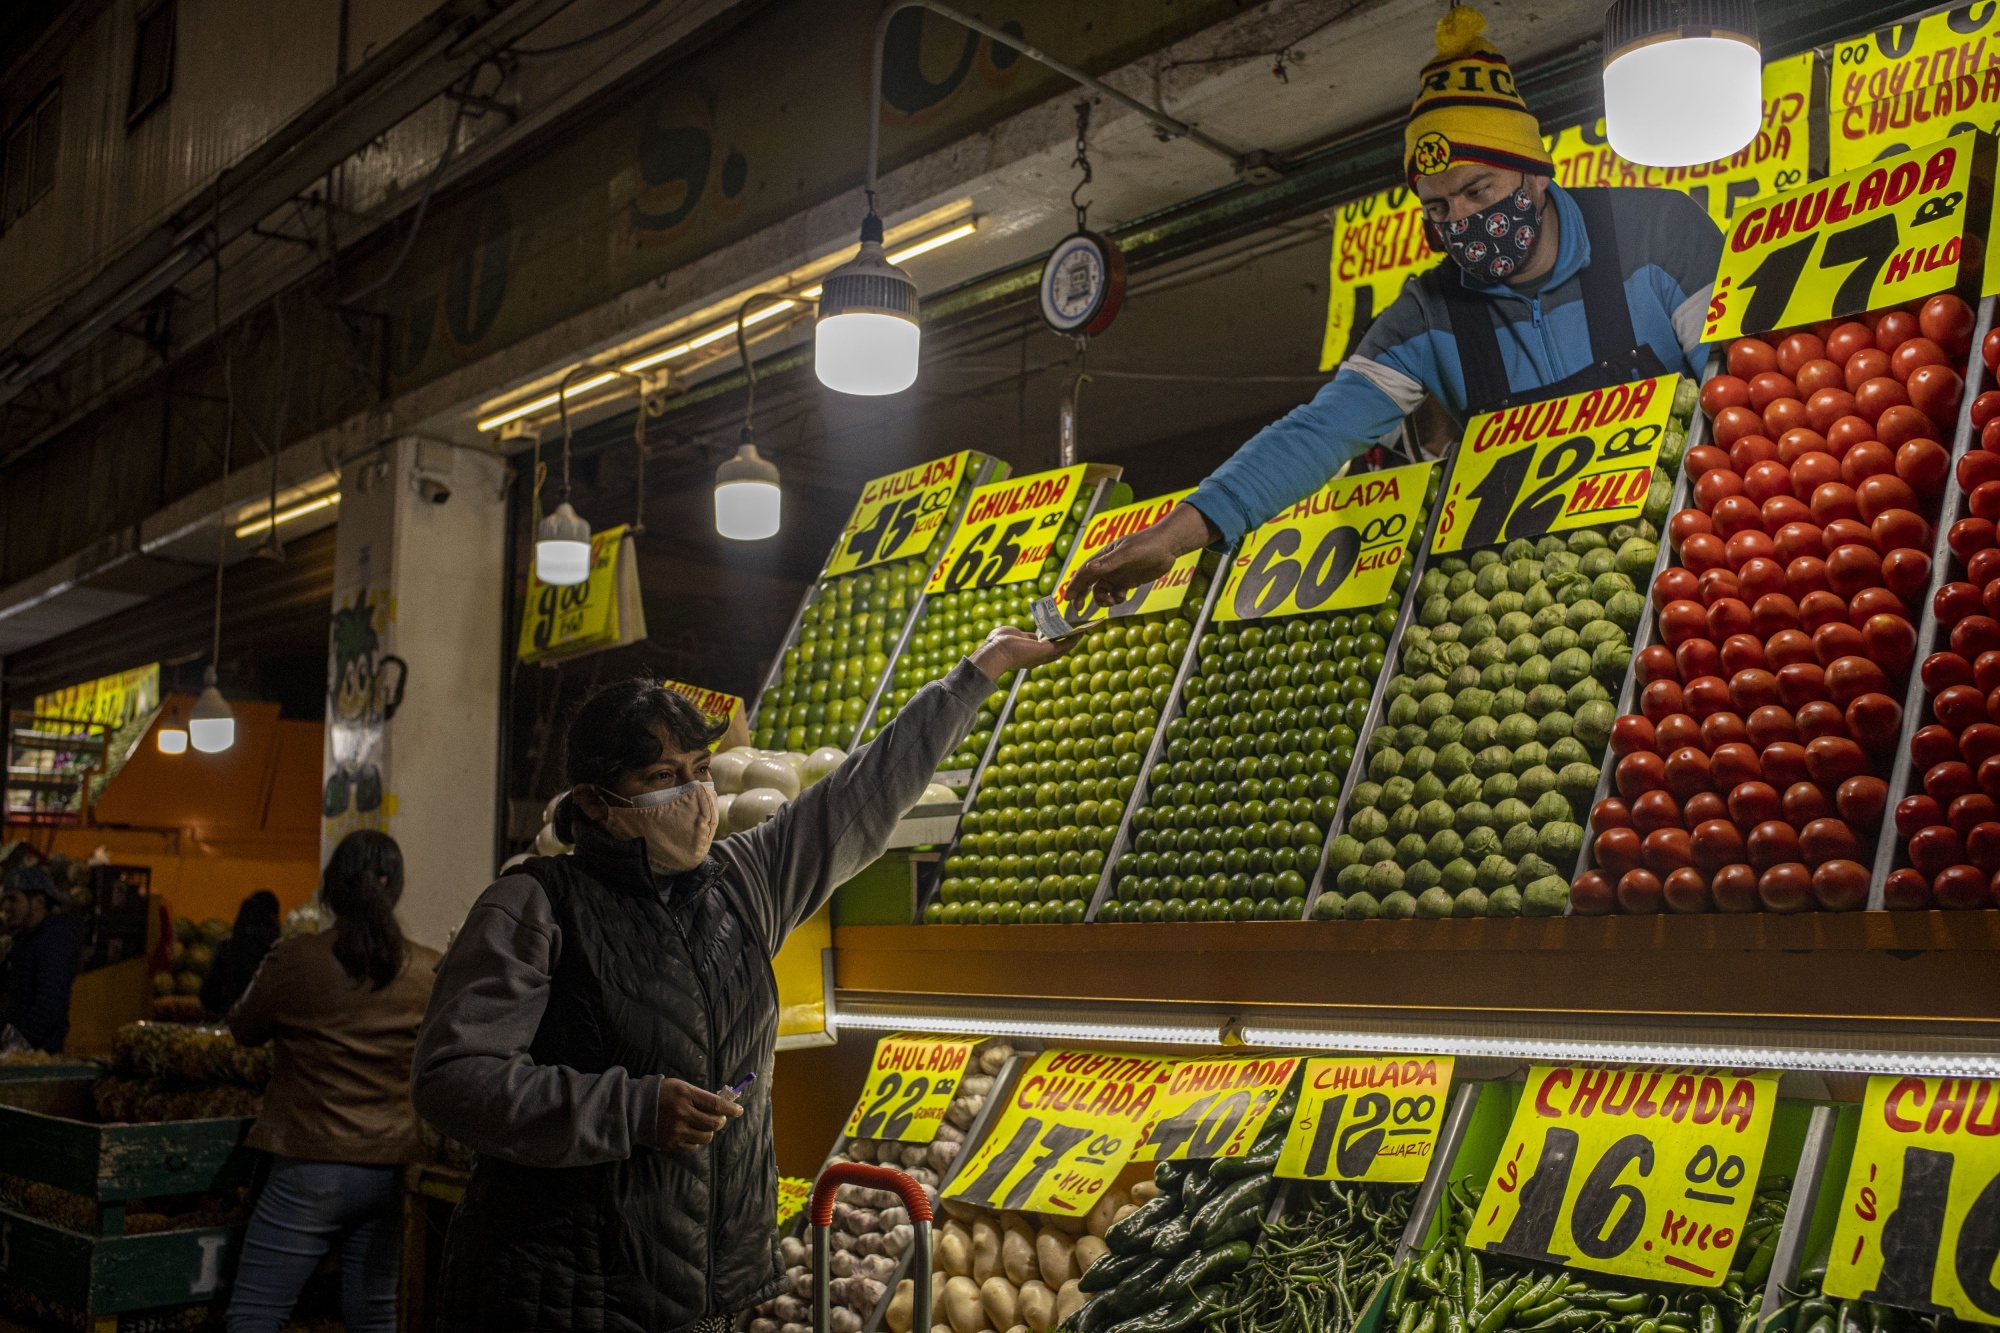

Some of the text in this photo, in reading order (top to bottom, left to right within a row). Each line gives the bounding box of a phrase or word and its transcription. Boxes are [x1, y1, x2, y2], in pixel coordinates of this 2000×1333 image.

[1736, 213, 1900, 335] 17
[1882, 236, 1962, 285] KILO
[1473, 378, 1657, 453] CHULADA
[863, 455, 957, 504] CHULADA
[967, 475, 1070, 525] CHULADA
[1461, 436, 1596, 549] 12
[1566, 468, 1652, 513] KILO
[1084, 499, 1174, 550] CHULA
[945, 517, 1046, 592] 65
[1015, 543, 1054, 567] KILO
[1234, 526, 1361, 619] 60
[1361, 513, 1407, 543] 00
[1355, 546, 1402, 579] KILO
[877, 1043, 967, 1073] CHULADA
[1169, 1058, 1296, 1096] CHULADA
[1313, 1059, 1437, 1090] CHULADA
[857, 1072, 929, 1139] 22
[1018, 1075, 1157, 1123] CHULADA
[1535, 1068, 1756, 1133] CHULADA
[1146, 1090, 1252, 1160] 40
[1304, 1092, 1392, 1179] 12
[1393, 1094, 1436, 1125] 00
[1375, 1141, 1432, 1159] CUARTO
[955, 1116, 1094, 1211] 17
[1087, 1134, 1122, 1157] 00
[1486, 1126, 1656, 1265] 16
[1685, 1144, 1746, 1189] 00
